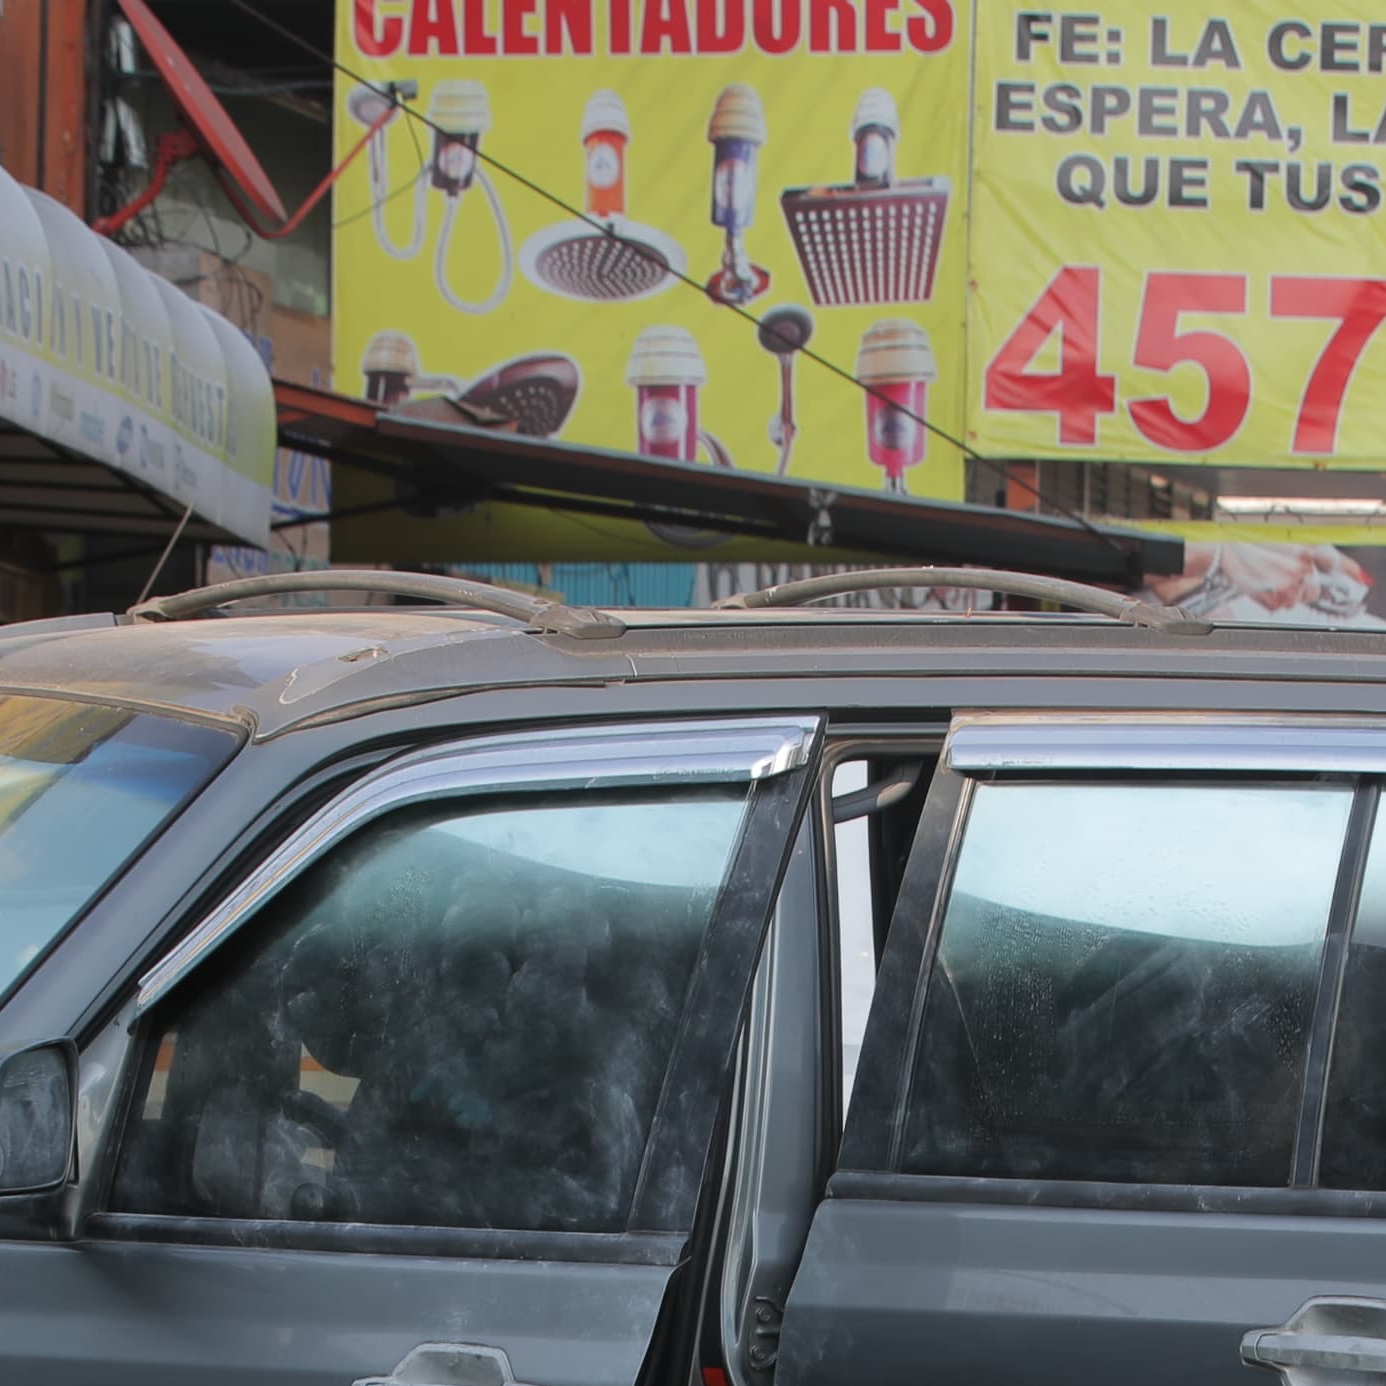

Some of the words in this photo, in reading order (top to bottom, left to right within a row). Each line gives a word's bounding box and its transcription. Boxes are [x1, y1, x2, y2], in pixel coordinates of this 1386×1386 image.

[1016, 13, 1122, 64] FE:
[1150, 18, 1241, 69] LA
[994, 82, 1303, 151] ESPERA,
[1057, 154, 1209, 209] QUE
[1235, 161, 1383, 215] TUS
